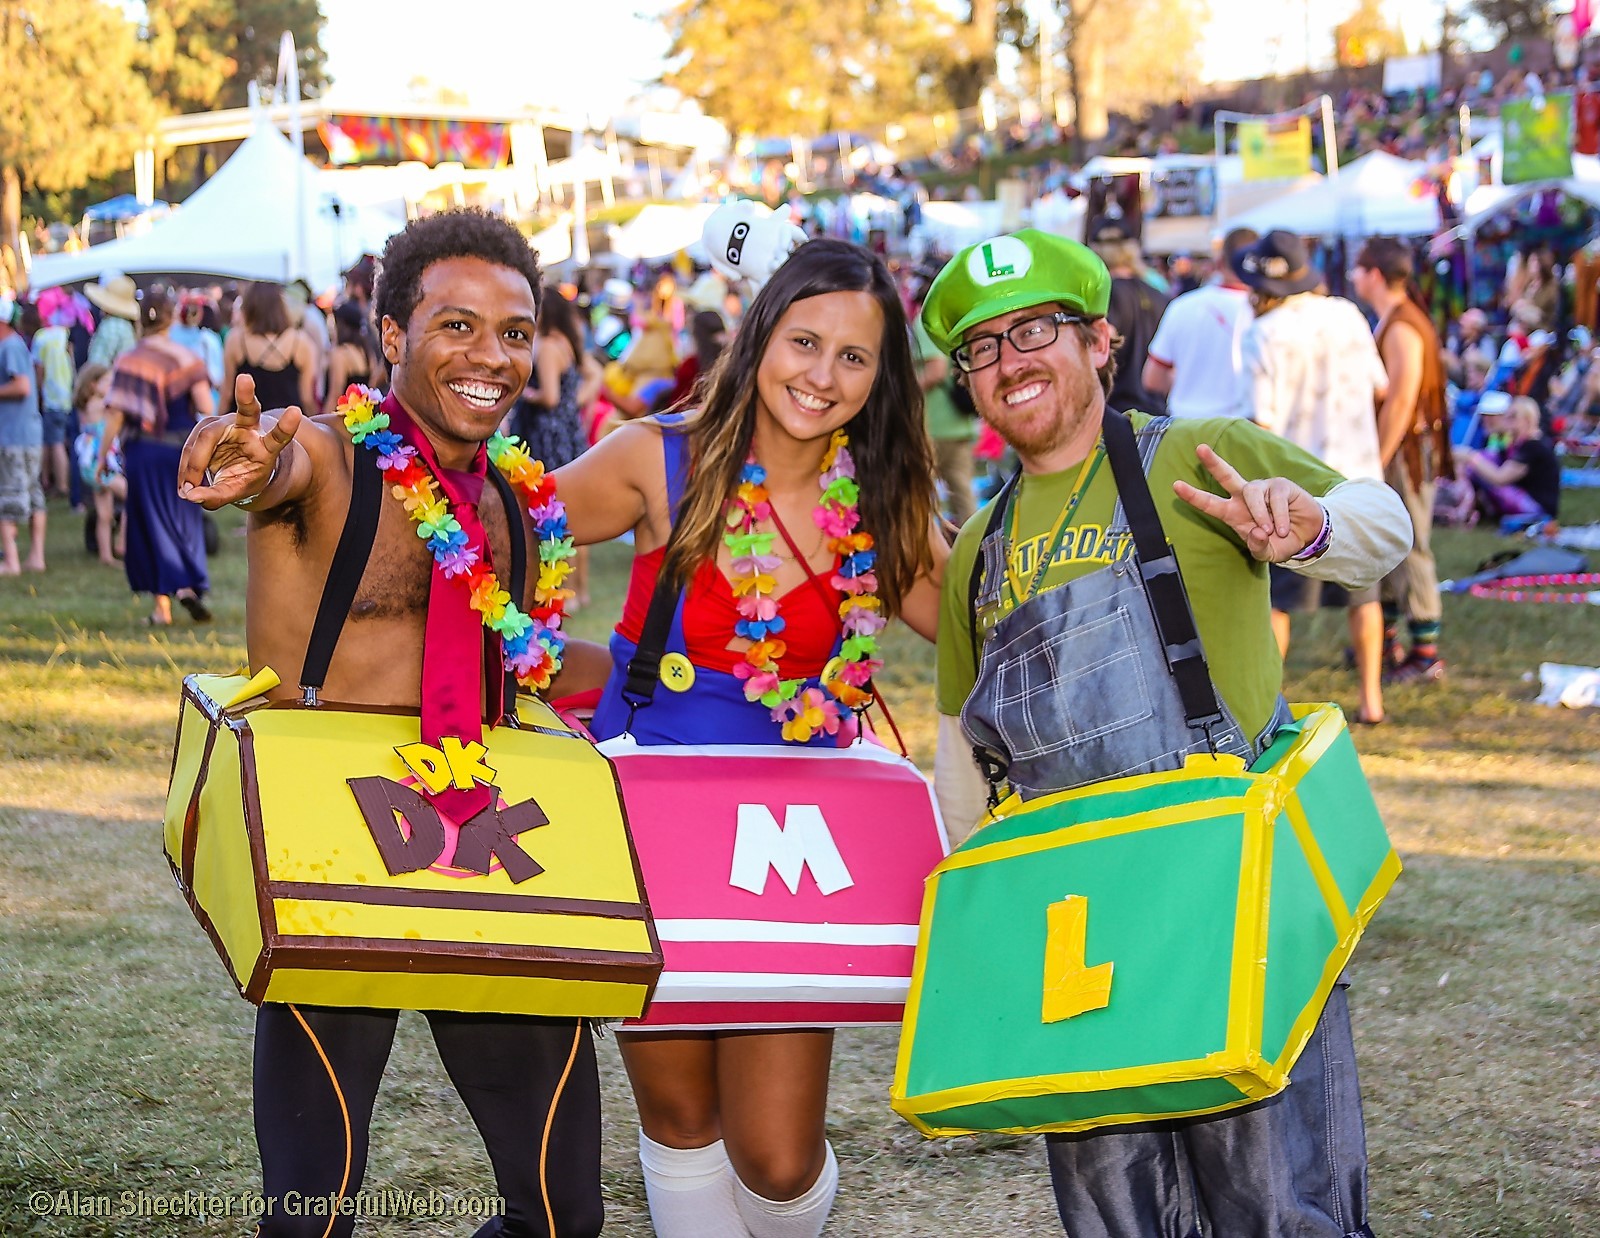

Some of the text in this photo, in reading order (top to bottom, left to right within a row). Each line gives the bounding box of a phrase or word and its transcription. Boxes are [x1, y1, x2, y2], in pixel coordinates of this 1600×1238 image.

[982, 243, 1014, 277] L
[393, 736, 498, 796] DK
[346, 775, 550, 885] DK
[728, 803, 855, 896] M
[1041, 894, 1114, 1024] L
